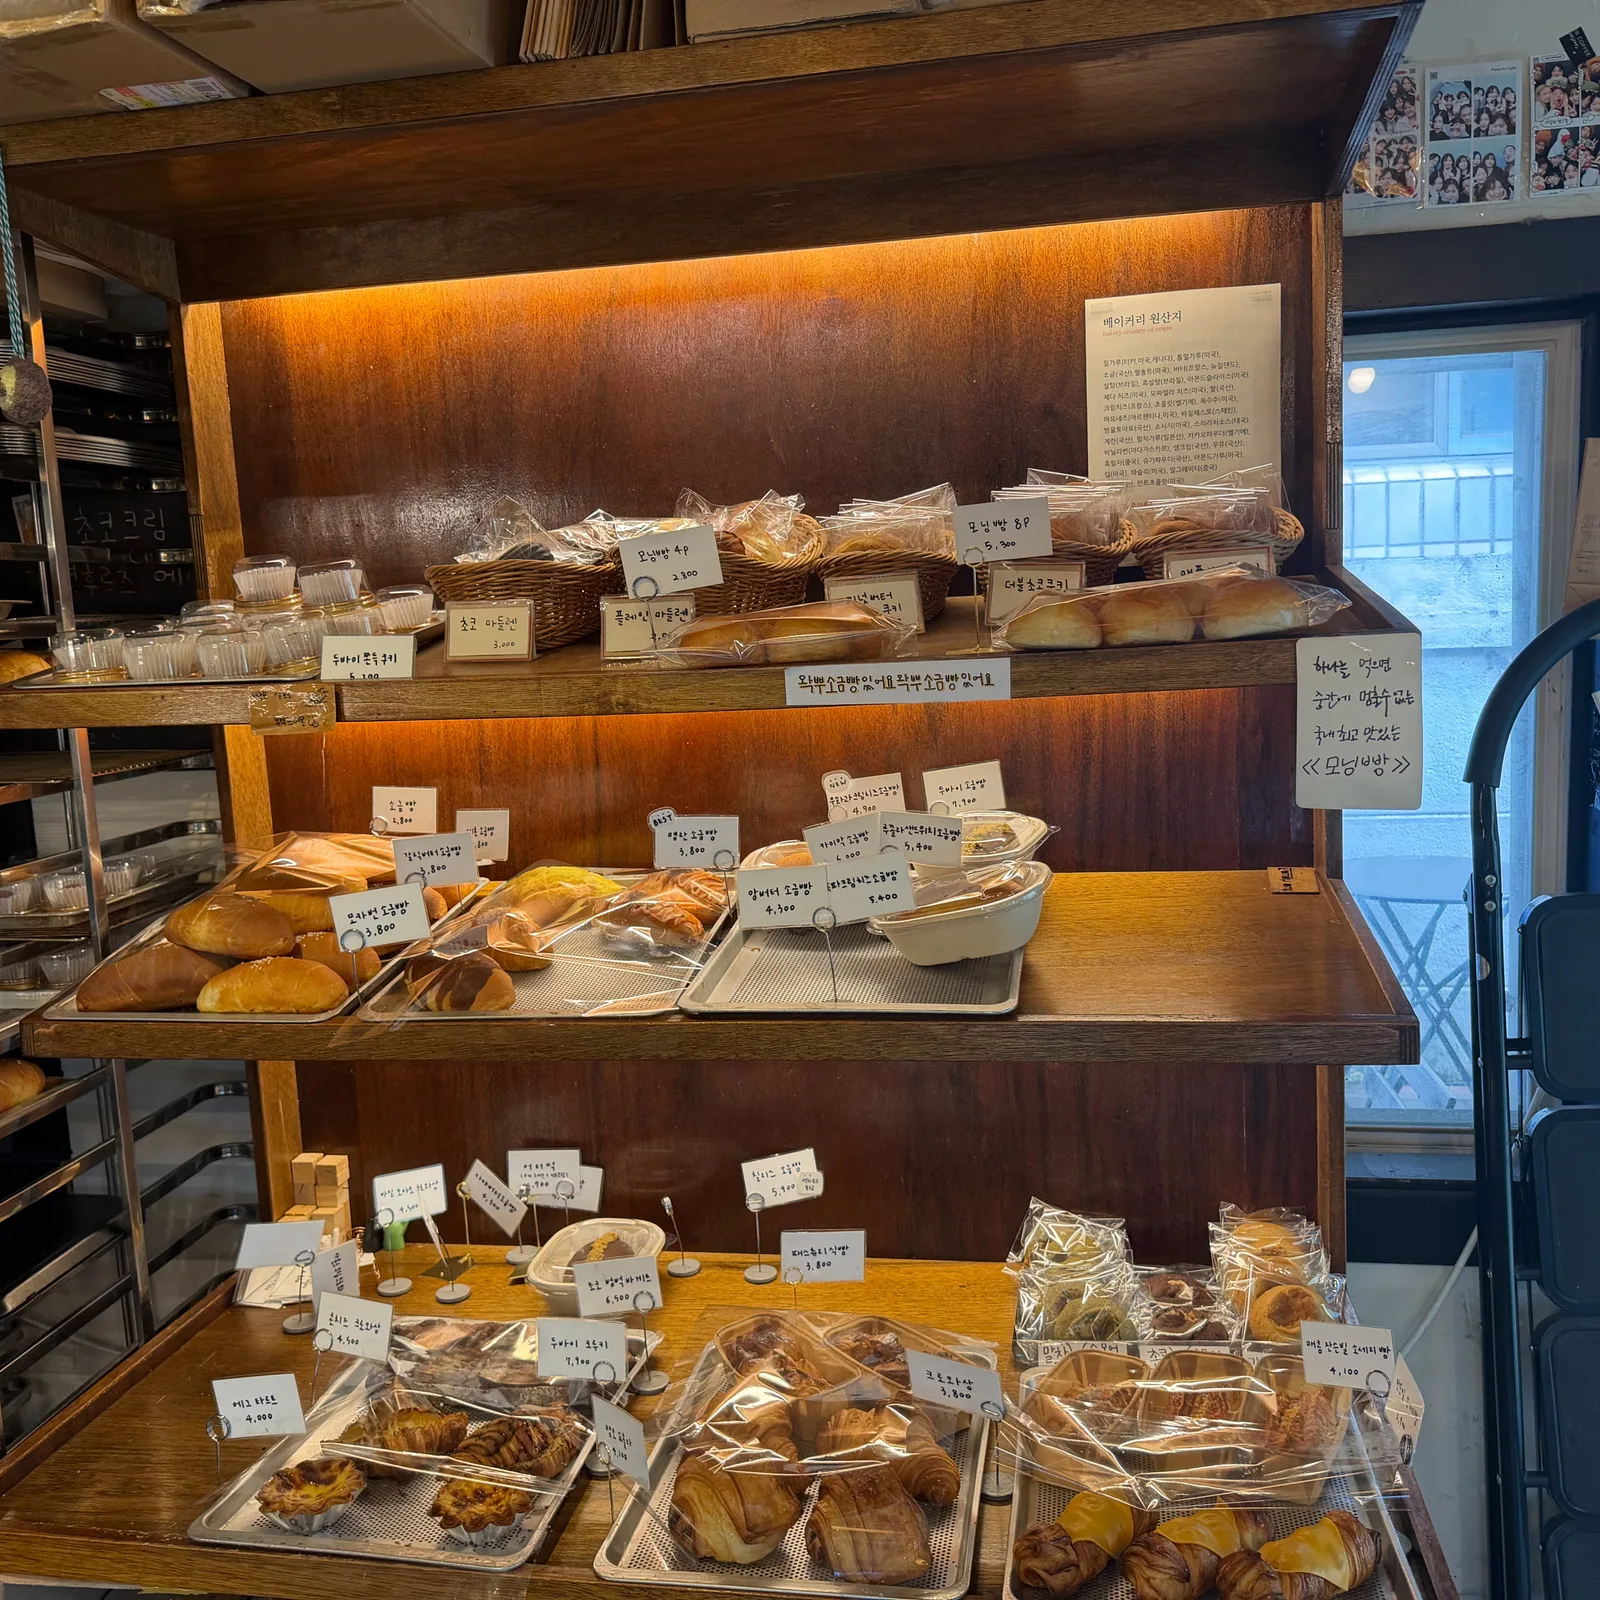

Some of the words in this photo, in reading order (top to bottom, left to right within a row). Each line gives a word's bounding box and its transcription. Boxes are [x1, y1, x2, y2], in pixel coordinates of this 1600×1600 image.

[1103, 313, 1146, 328] 베이커리
[1150, 310, 1182, 324] 원산지
[74, 507, 166, 545] 초코크림
[968, 520, 1008, 534] 모닝빵
[638, 548, 670, 563] 모닝빵
[846, 592, 893, 605] 넛버터
[883, 603, 902, 614] 쿠키
[460, 616, 477, 632] 초코
[485, 615, 518, 632] 마들렌
[615, 610, 649, 627] 플레인
[655, 608, 689, 623] 마들렌
[333, 654, 360, 666] 두바이
[1313, 655, 1351, 679] 하나를
[1359, 657, 1392, 678] 먹으면
[1312, 691, 1351, 711] 중간에
[1363, 725, 1402, 743] 맛있는
[829, 779, 847, 789] NEW
[938, 784, 963, 796] 두바이
[964, 777, 987, 793] 소금빵
[389, 800, 417, 813] 소금빵
[652, 814, 673, 827] BEST
[667, 831, 688, 842] 명란
[691, 829, 718, 842] 소금빵
[819, 836, 846, 851] 카이막
[847, 830, 869, 842] 소금빵
[747, 887, 780, 901] 앙버터
[785, 882, 813, 896] 소금빵
[347, 909, 378, 925] 모카번
[381, 901, 410, 917] 소금빵
[781, 1161, 801, 1175] 소금빵
[588, 1280, 602, 1291] 초코
[354, 1318, 381, 1334] 크로와상
[550, 1337, 578, 1349] 두바이
[1306, 1340, 1322, 1354] 매콤
[926, 1370, 974, 1391] 크로와상
[232, 1399, 252, 1409] 에그
[255, 1394, 278, 1406] 타르트
